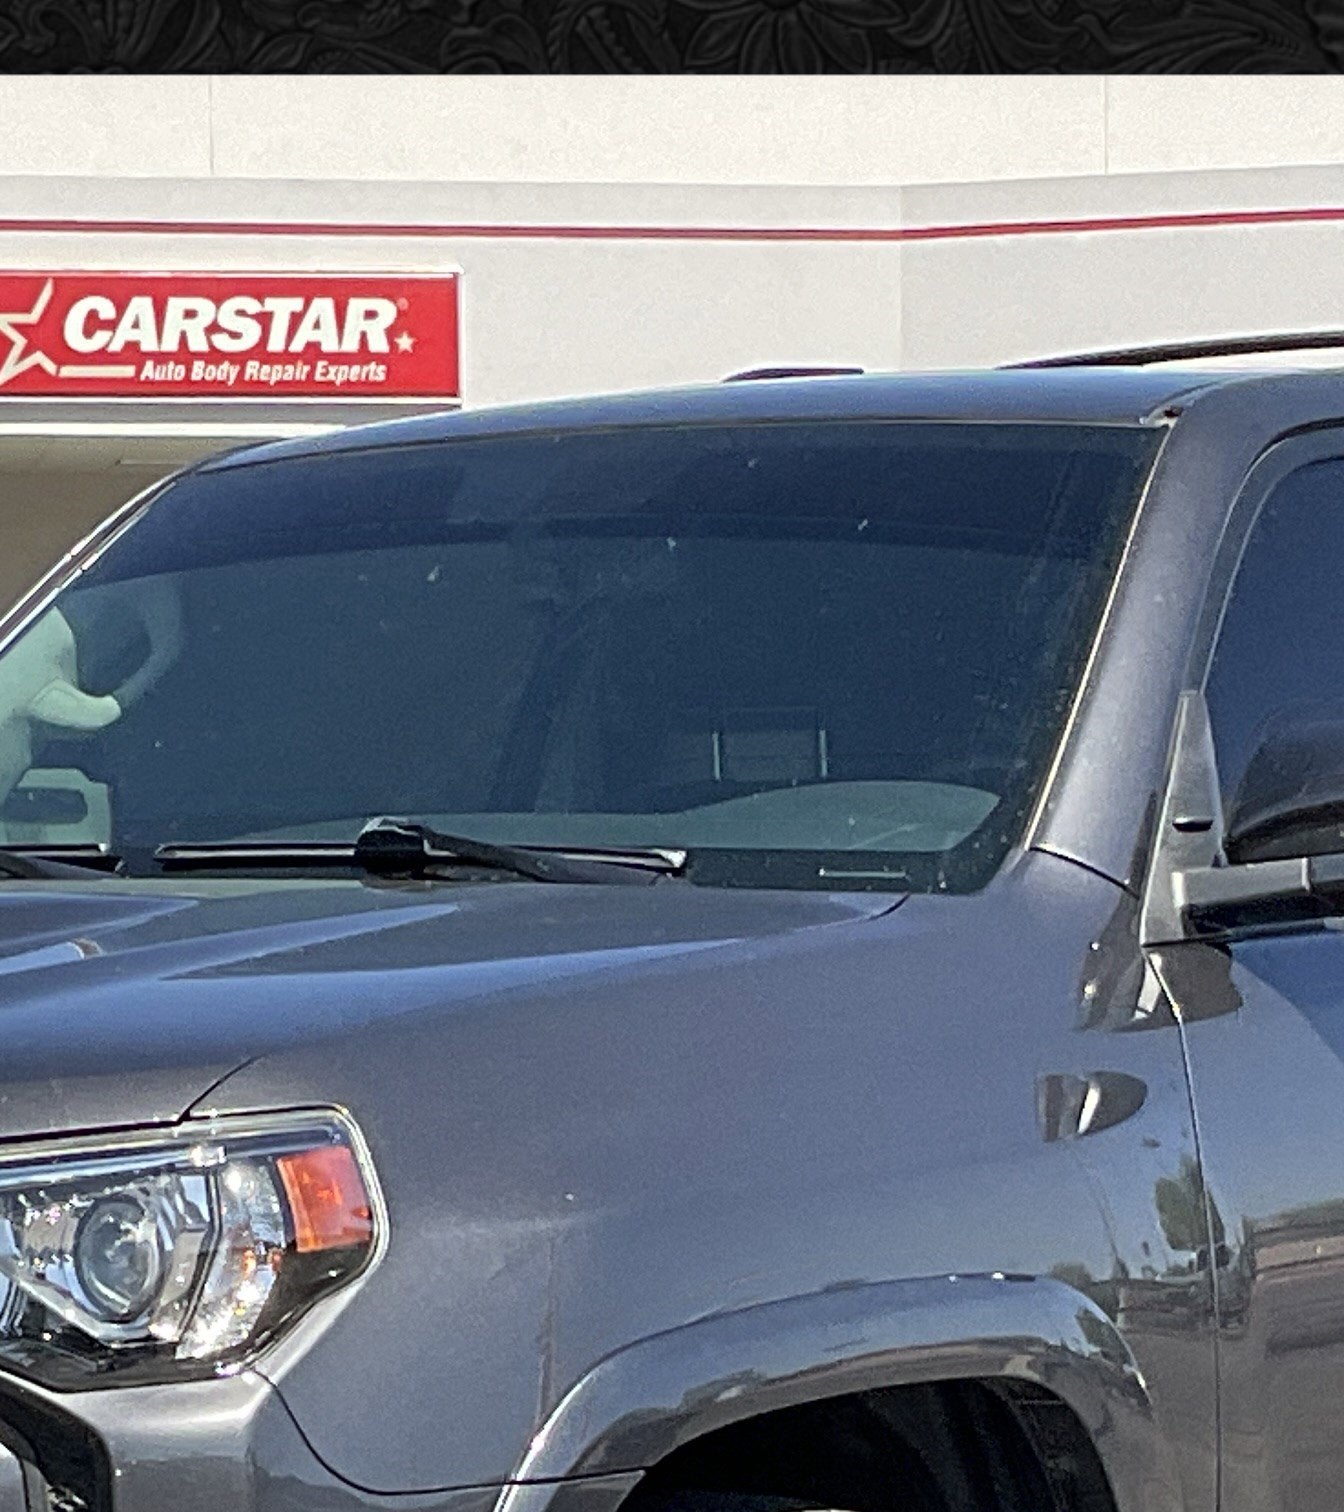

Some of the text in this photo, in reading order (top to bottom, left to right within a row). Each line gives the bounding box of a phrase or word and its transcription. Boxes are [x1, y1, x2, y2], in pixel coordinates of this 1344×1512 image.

[63, 295, 398, 353] CARSTAR
[140, 360, 387, 386] Auto Body Repair Experts
